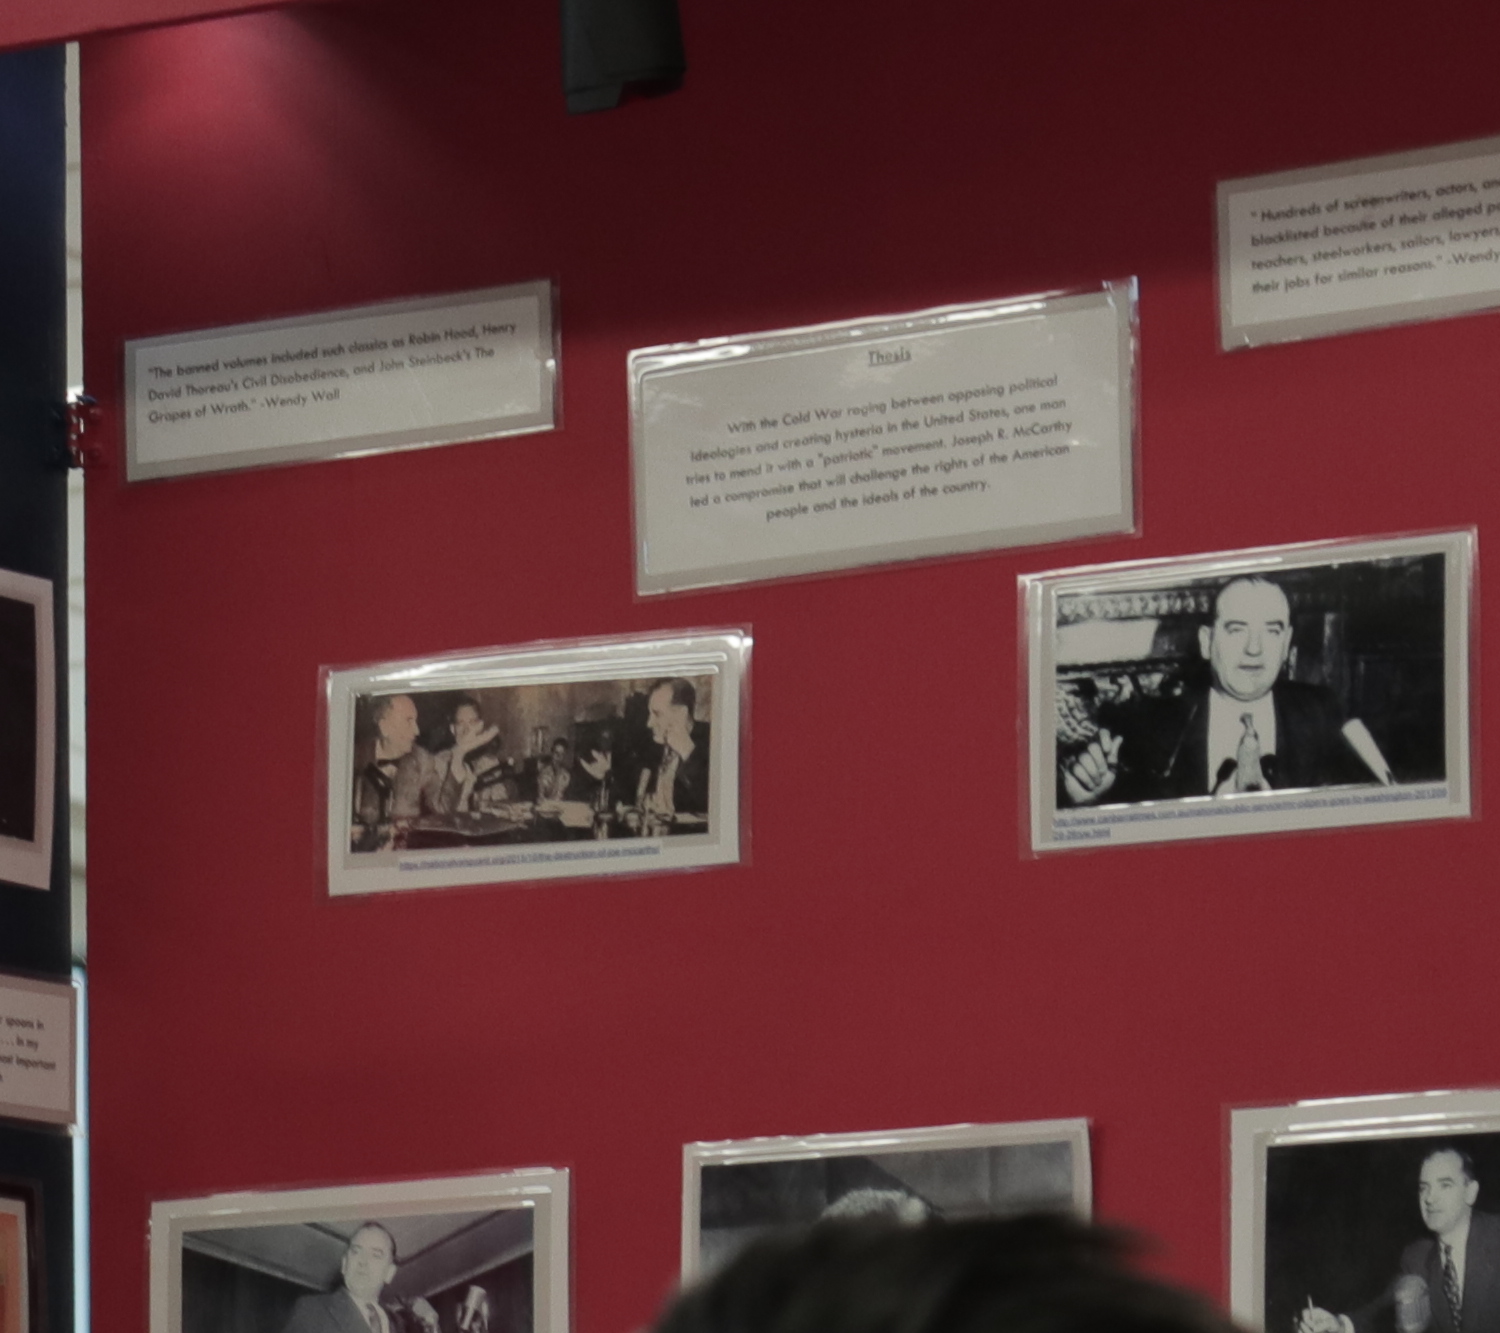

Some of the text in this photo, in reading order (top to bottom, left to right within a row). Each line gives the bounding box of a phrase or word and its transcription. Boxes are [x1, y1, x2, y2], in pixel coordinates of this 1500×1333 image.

[147, 323, 516, 378] "The banned volumes included such classics as Robin Hood, Henry
[147, 346, 495, 402] David Thoreau's Civil Disobedience, and John Steinbeck's The
[868, 346, 912, 365] Thesis
[147, 410, 191, 424] Grapes
[194, 404, 206, 418] of
[310, 388, 340, 402] Wall
[726, 374, 1058, 433] With the Cold War raging between opposing political
